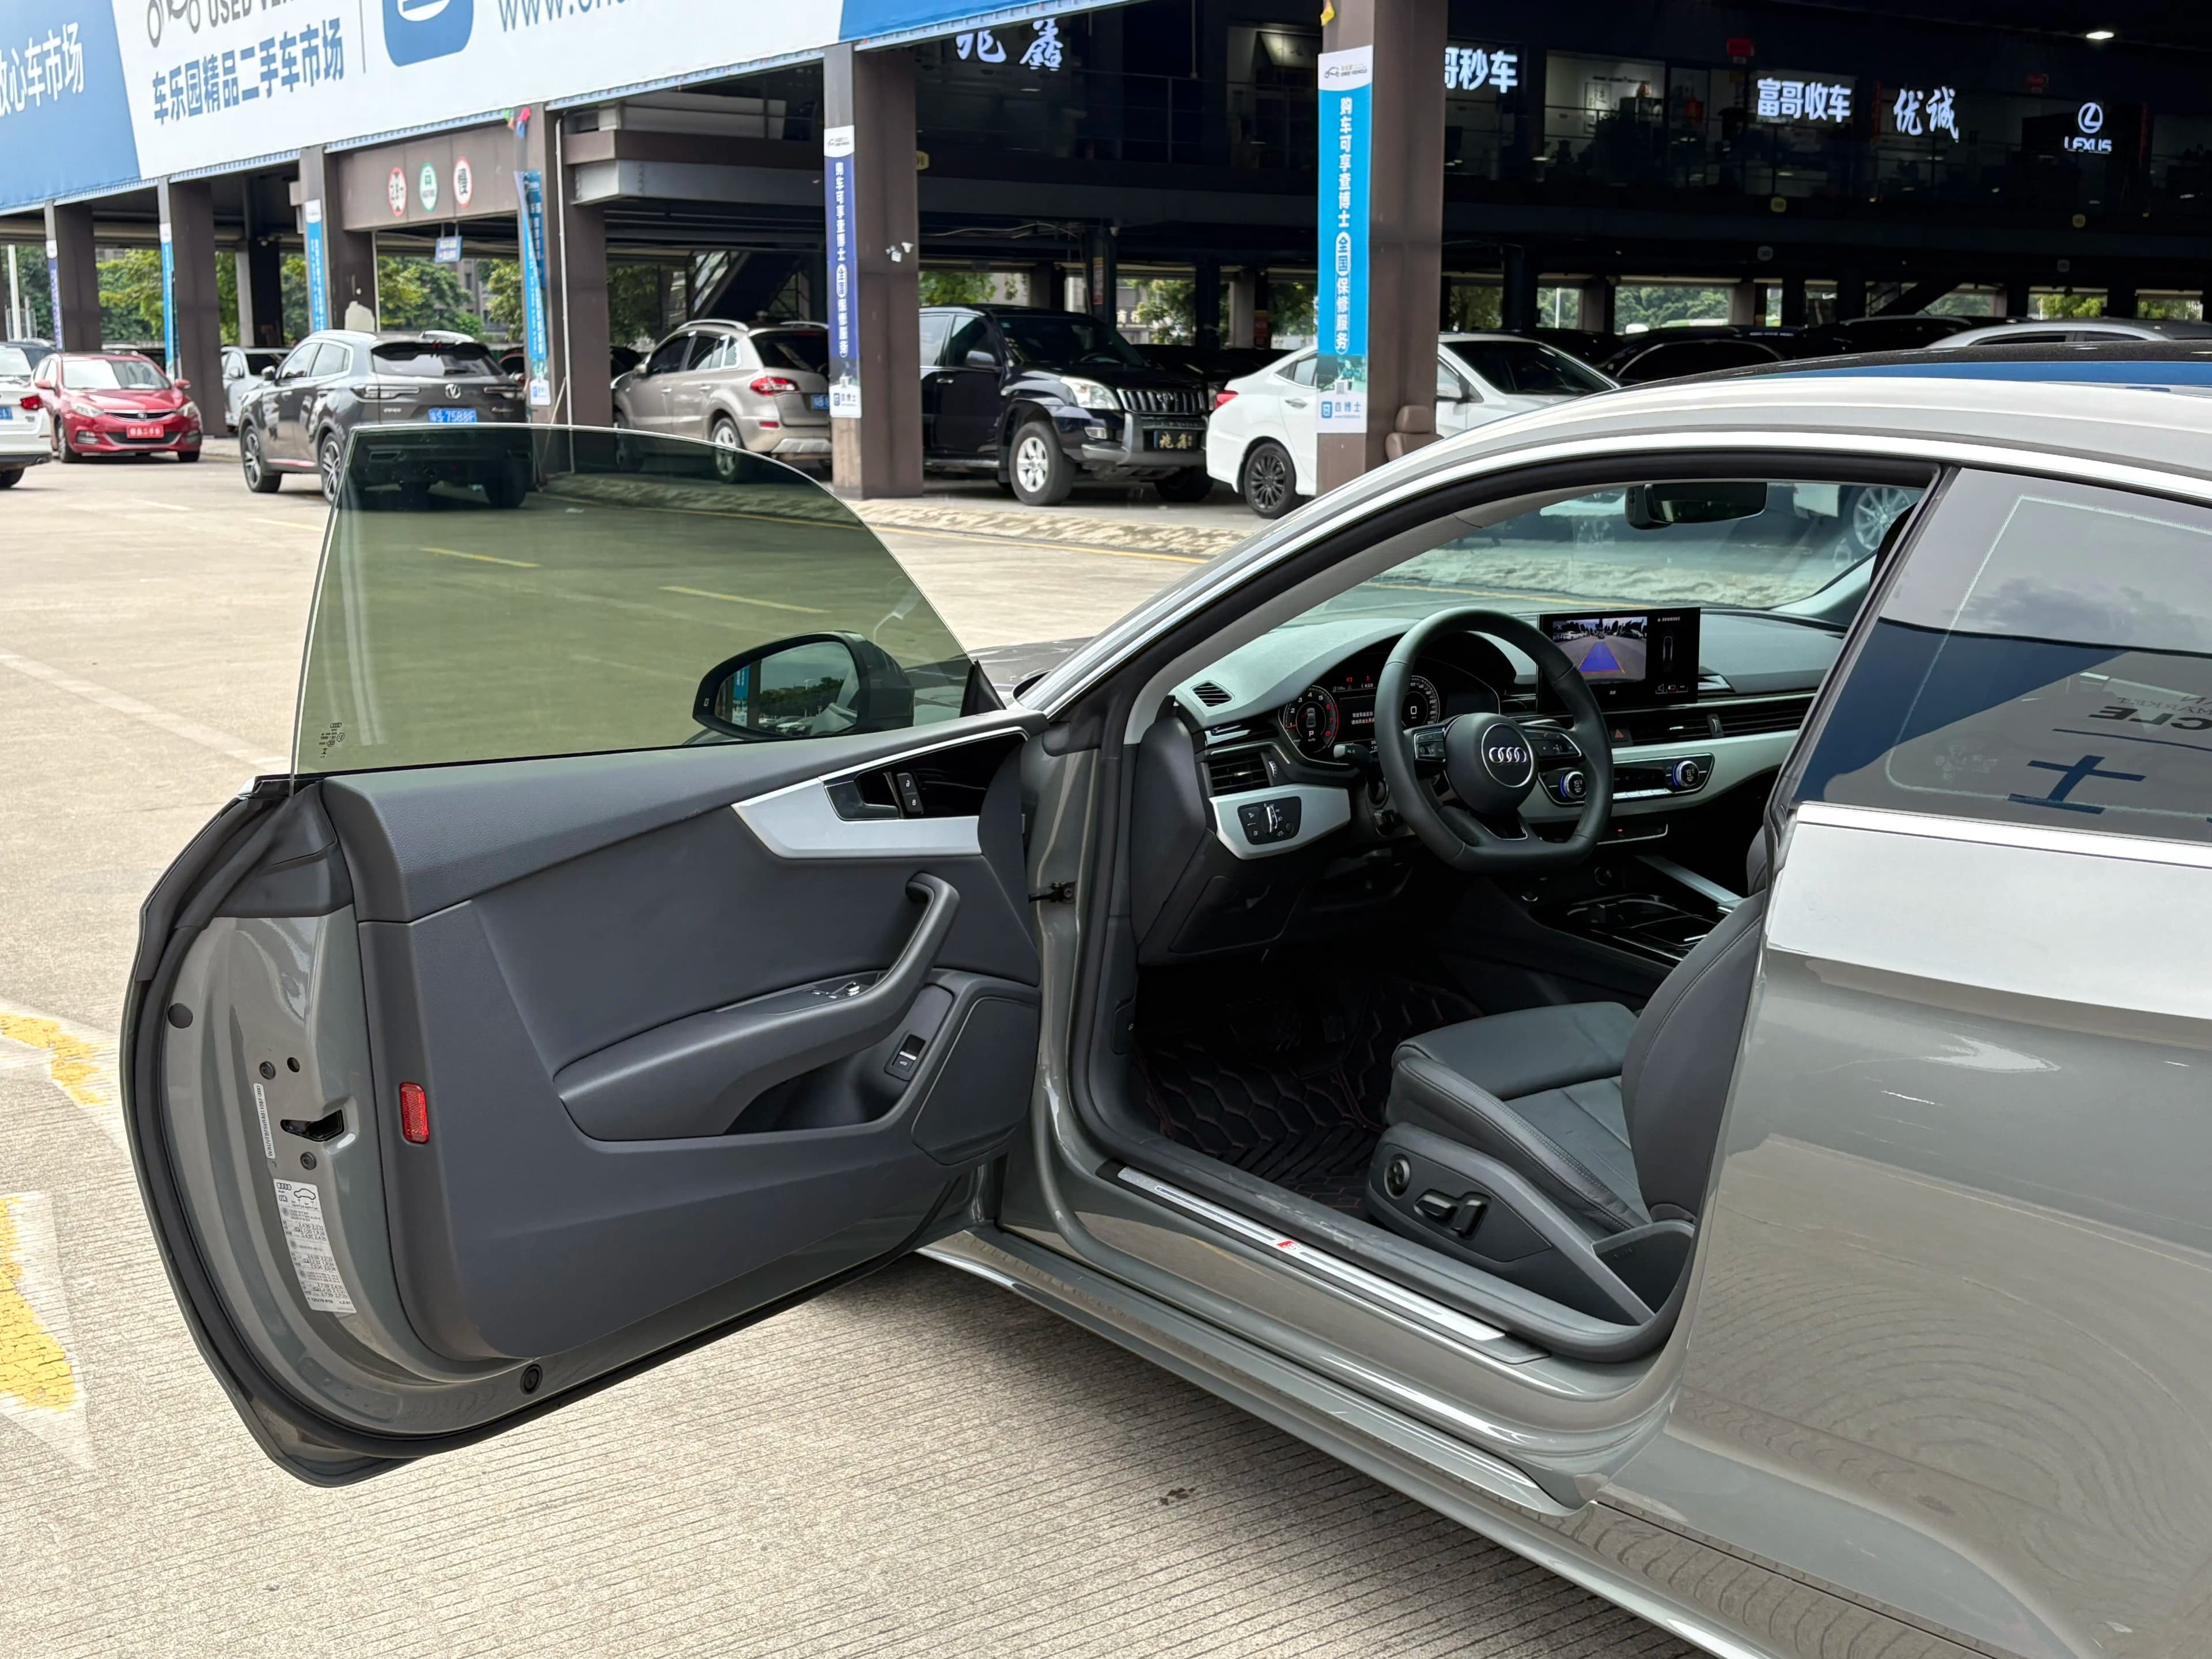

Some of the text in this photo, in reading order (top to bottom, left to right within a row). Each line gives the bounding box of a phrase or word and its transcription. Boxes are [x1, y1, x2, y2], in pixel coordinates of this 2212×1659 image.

[152, 17, 344, 126] 车乐园精品二手车市场
[1757, 77, 1852, 123] 富哥收车
[1893, 86, 1959, 143] 优诚
[2064, 136, 2112, 152] LEXUS
[1410, 706, 1417, 714] 0
